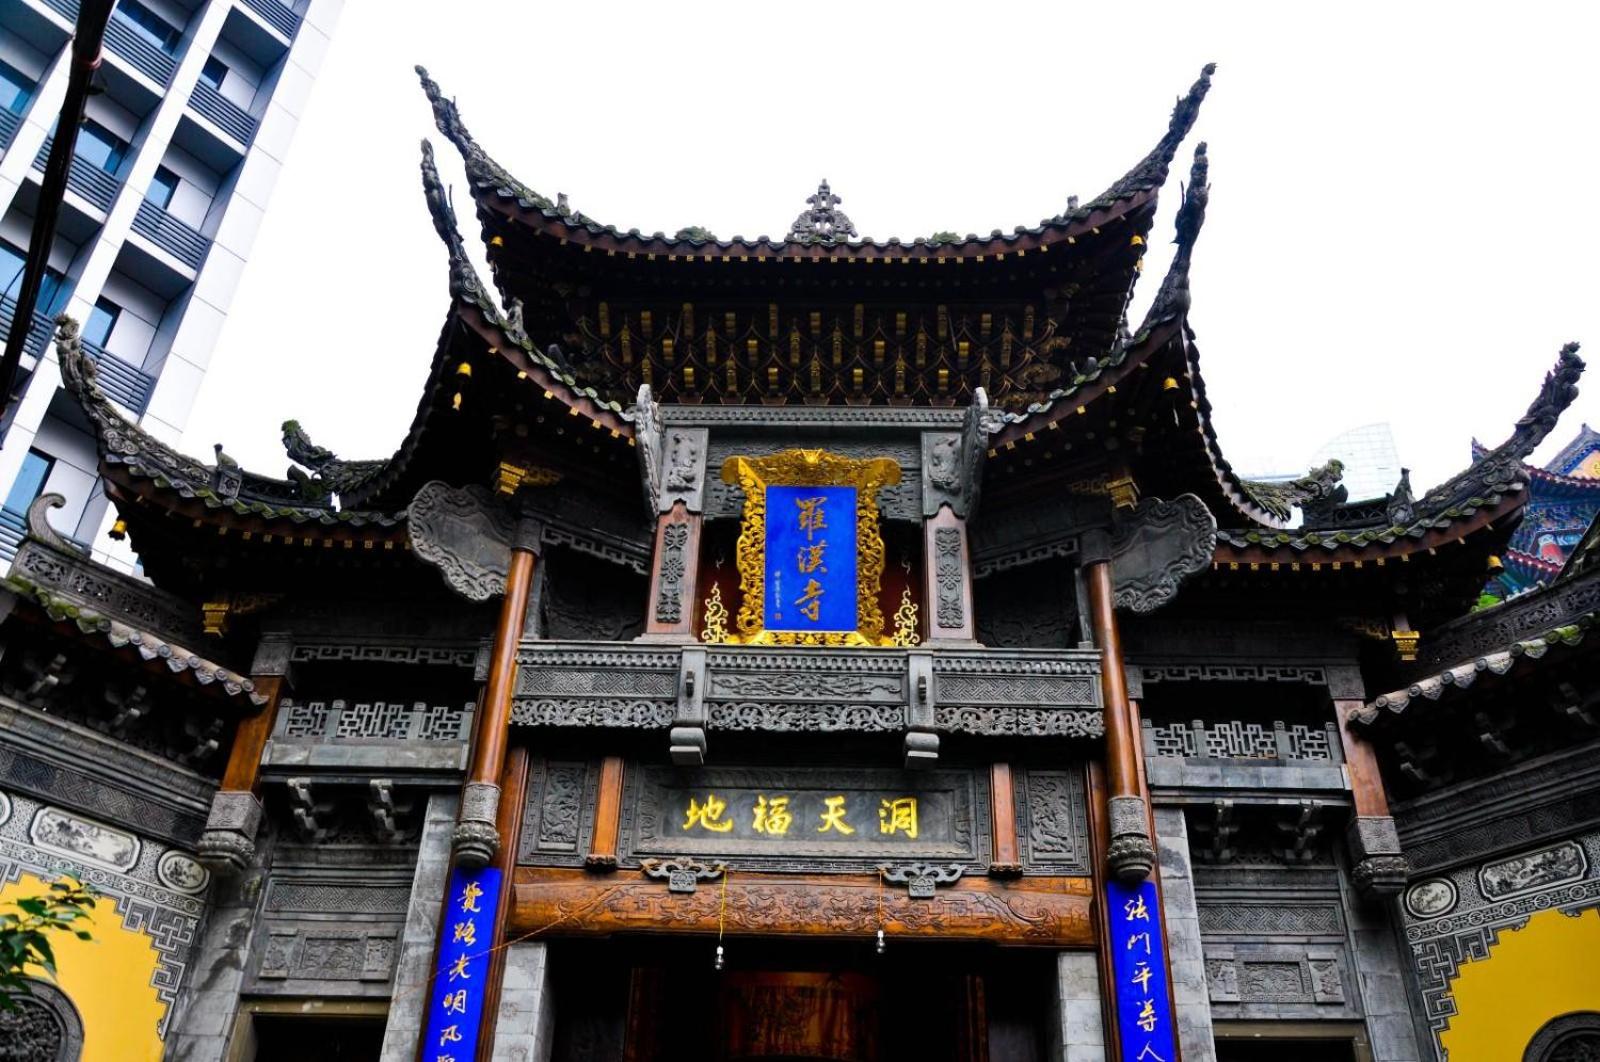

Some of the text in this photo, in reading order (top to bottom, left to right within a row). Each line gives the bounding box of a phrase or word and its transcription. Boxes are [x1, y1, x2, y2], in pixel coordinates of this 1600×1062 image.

[794, 496, 828, 621] 羅漢寺
[437, 881, 484, 1062] 覺路光明凡
